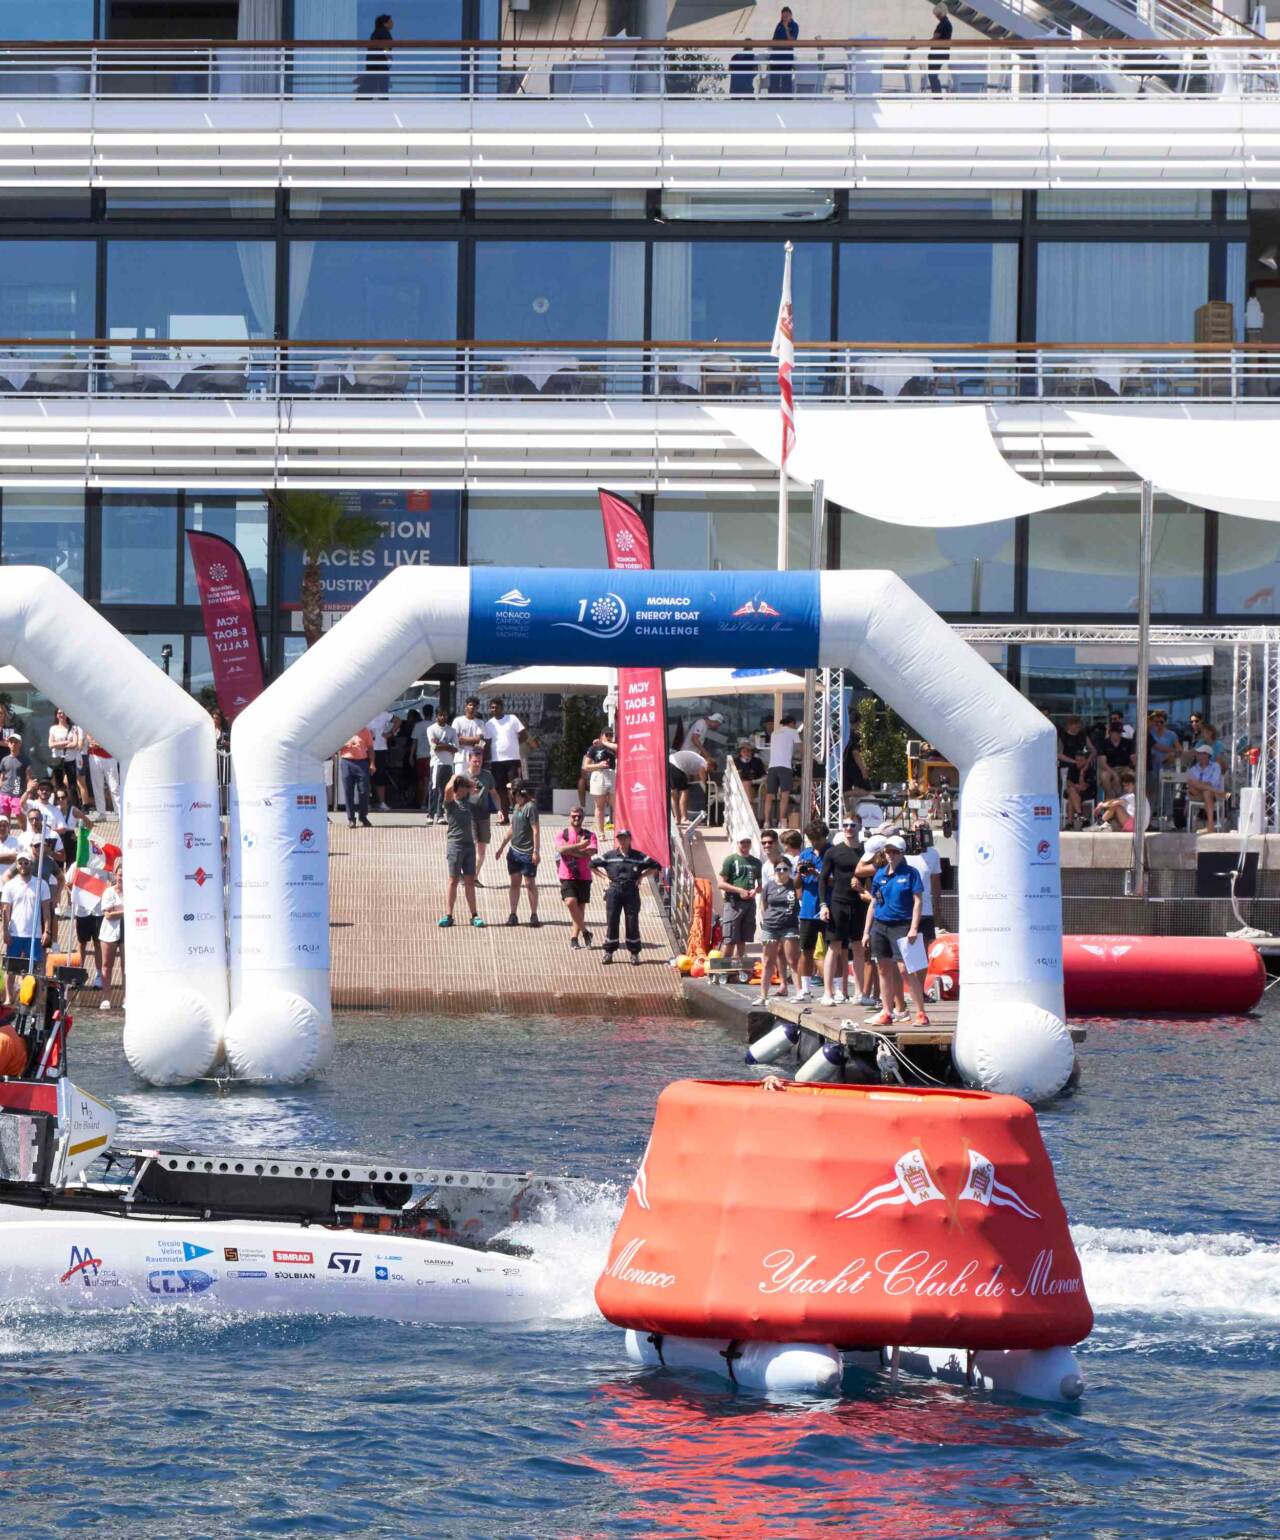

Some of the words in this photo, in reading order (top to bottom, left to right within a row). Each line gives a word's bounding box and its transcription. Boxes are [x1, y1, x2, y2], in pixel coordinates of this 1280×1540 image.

[383, 549, 431, 567] LIVE
[647, 597, 691, 606] MONACO
[495, 611, 531, 619] MONACO
[635, 611, 672, 620] ENERGY
[674, 611, 700, 621] BOAT
[634, 626, 699, 636] CHALLENGE
[276, 1253, 311, 1262] SIMRAD
[605, 1238, 676, 1288] Monaco
[274, 1271, 316, 1280] SOLBIAN
[758, 1249, 873, 1294] Yacht
[875, 1249, 980, 1296] Club
[974, 1263, 1005, 1297] de
